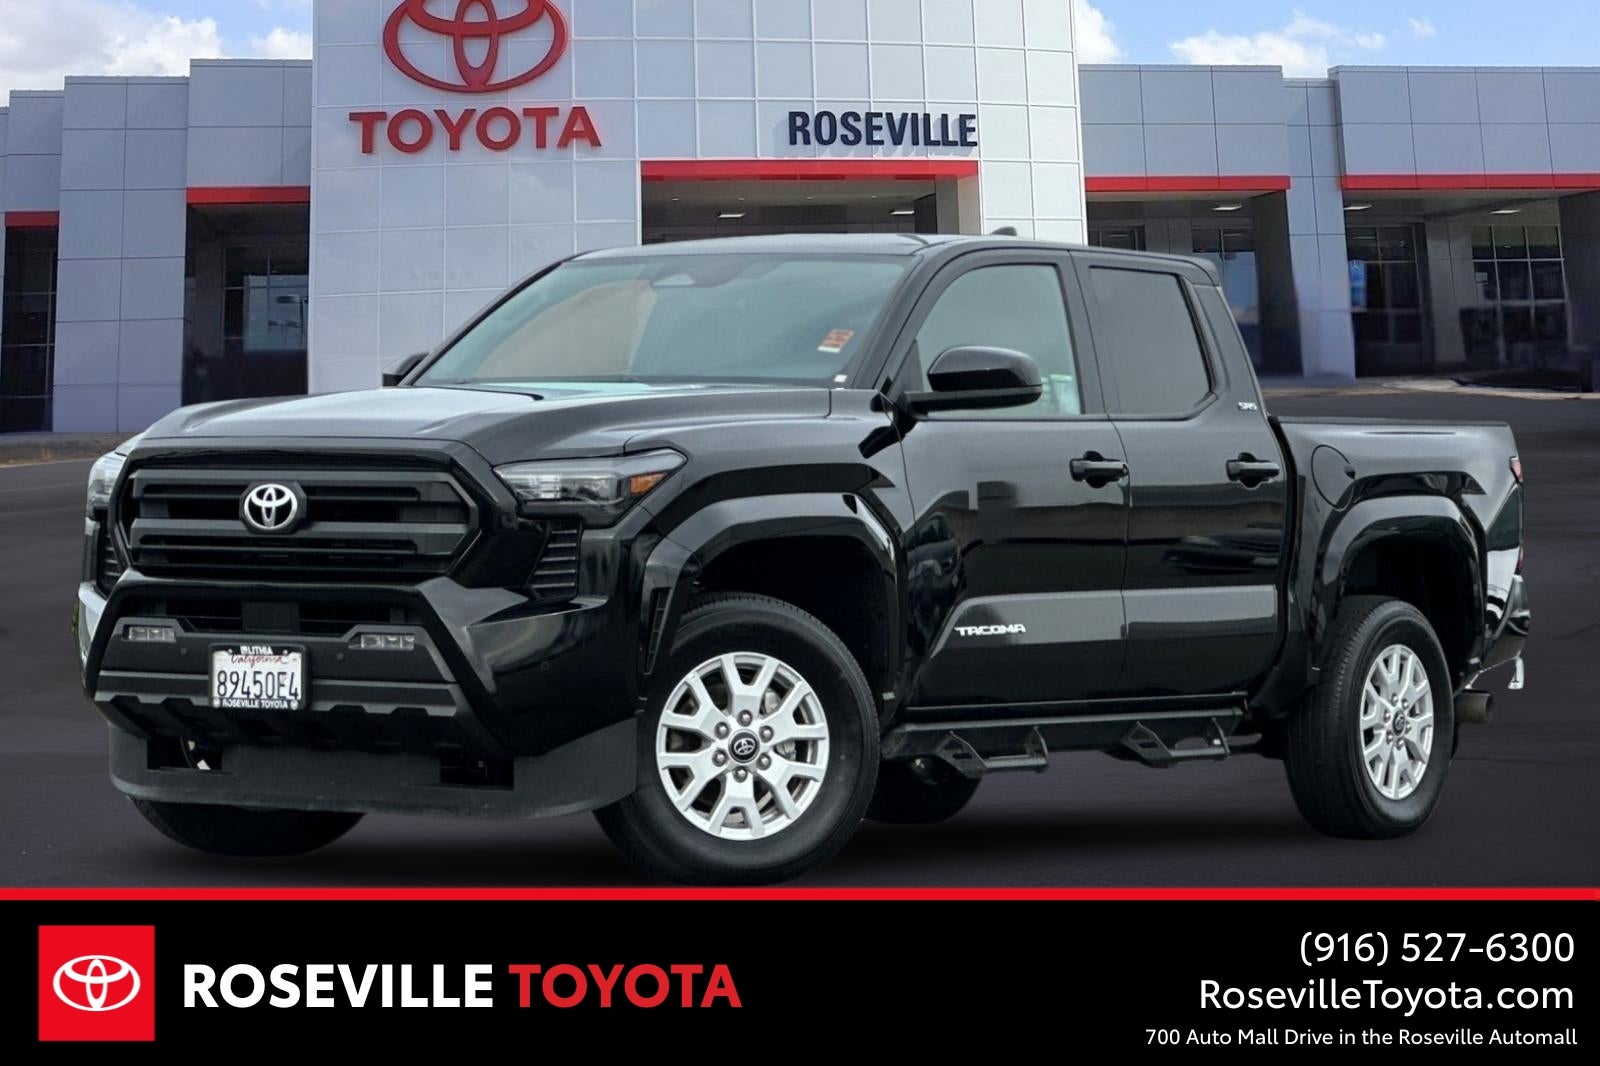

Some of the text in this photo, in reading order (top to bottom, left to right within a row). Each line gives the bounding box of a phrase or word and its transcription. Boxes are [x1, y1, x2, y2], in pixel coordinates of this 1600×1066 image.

[349, 106, 602, 154] TOYOTA
[788, 110, 978, 147] ROSEVILLE
[954, 623, 1026, 637] TACOMA
[217, 670, 299, 700] 89450E4
[222, 699, 288, 709] ROSEVILLE TOYOTA
